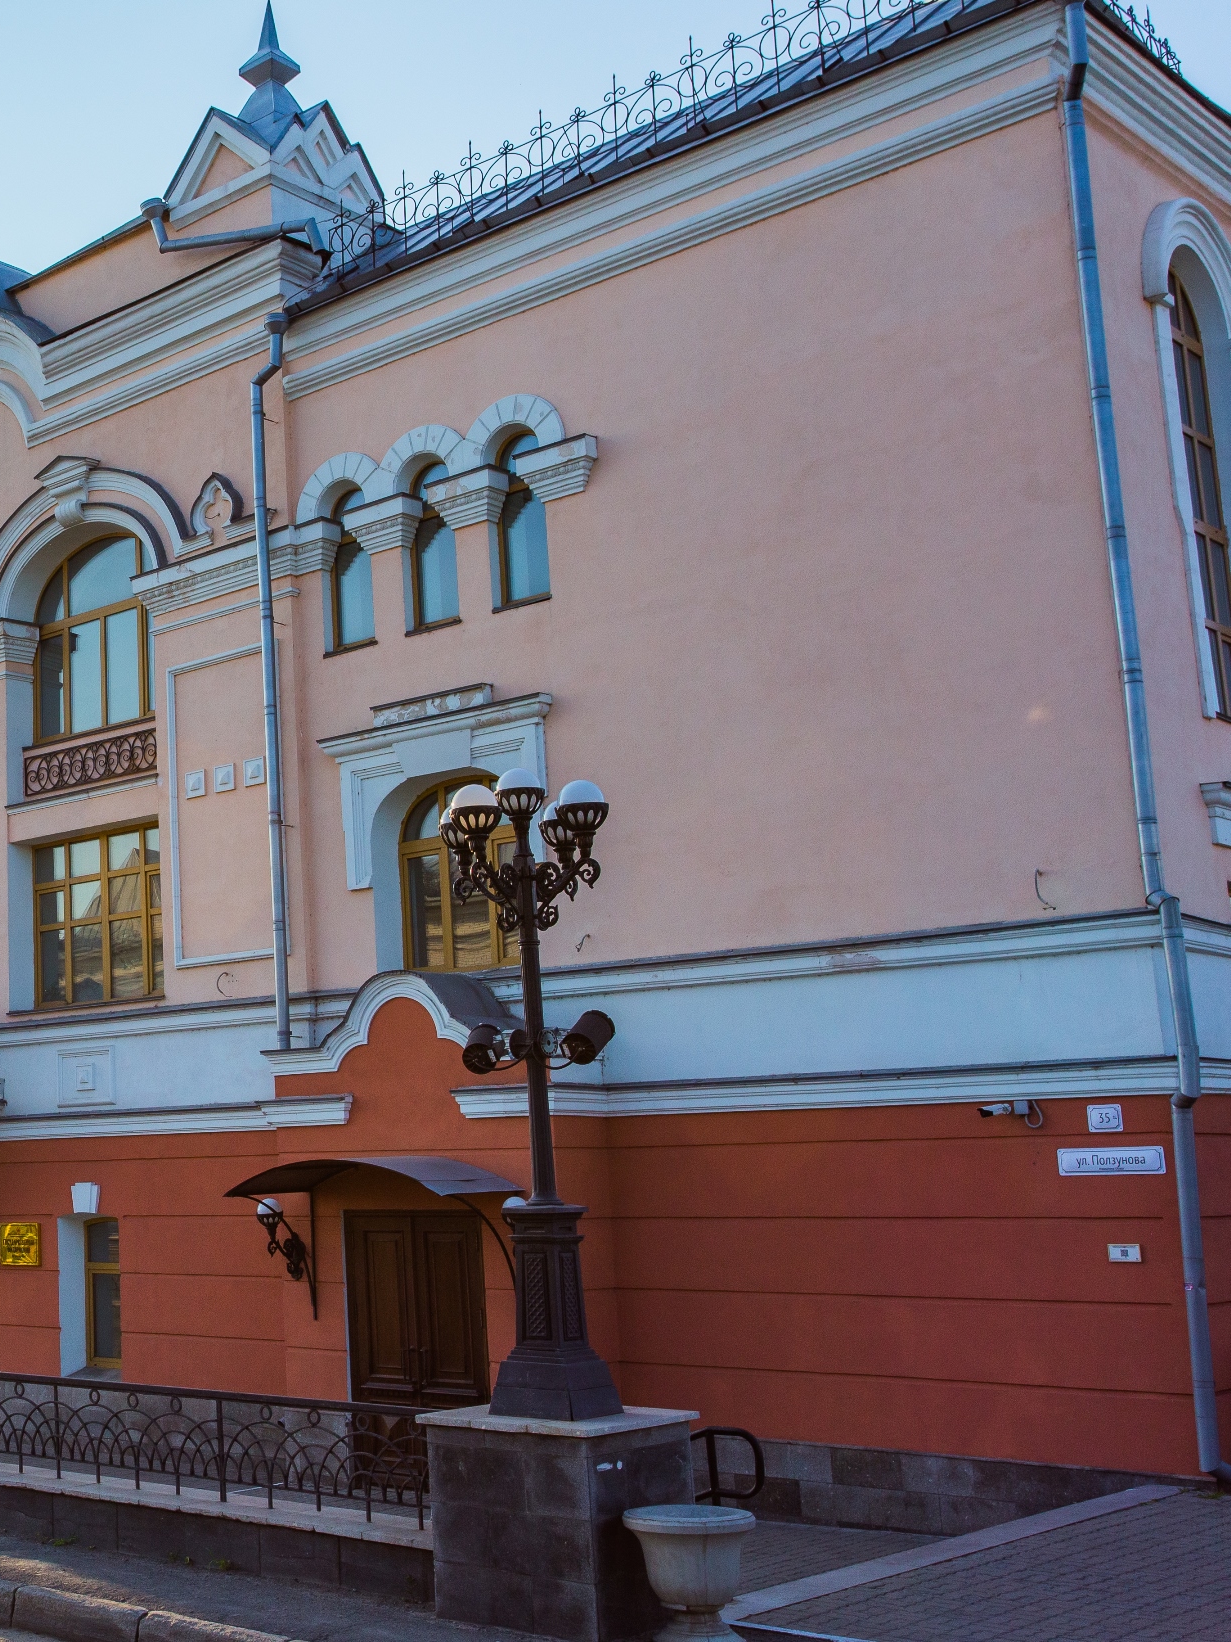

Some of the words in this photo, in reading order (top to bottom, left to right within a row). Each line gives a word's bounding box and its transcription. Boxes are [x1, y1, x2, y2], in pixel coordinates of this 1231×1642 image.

[1098, 1112, 1111, 1123] 35
[1076, 1158, 1090, 1168] ул.
[1091, 1155, 1146, 1167] Ползунова
